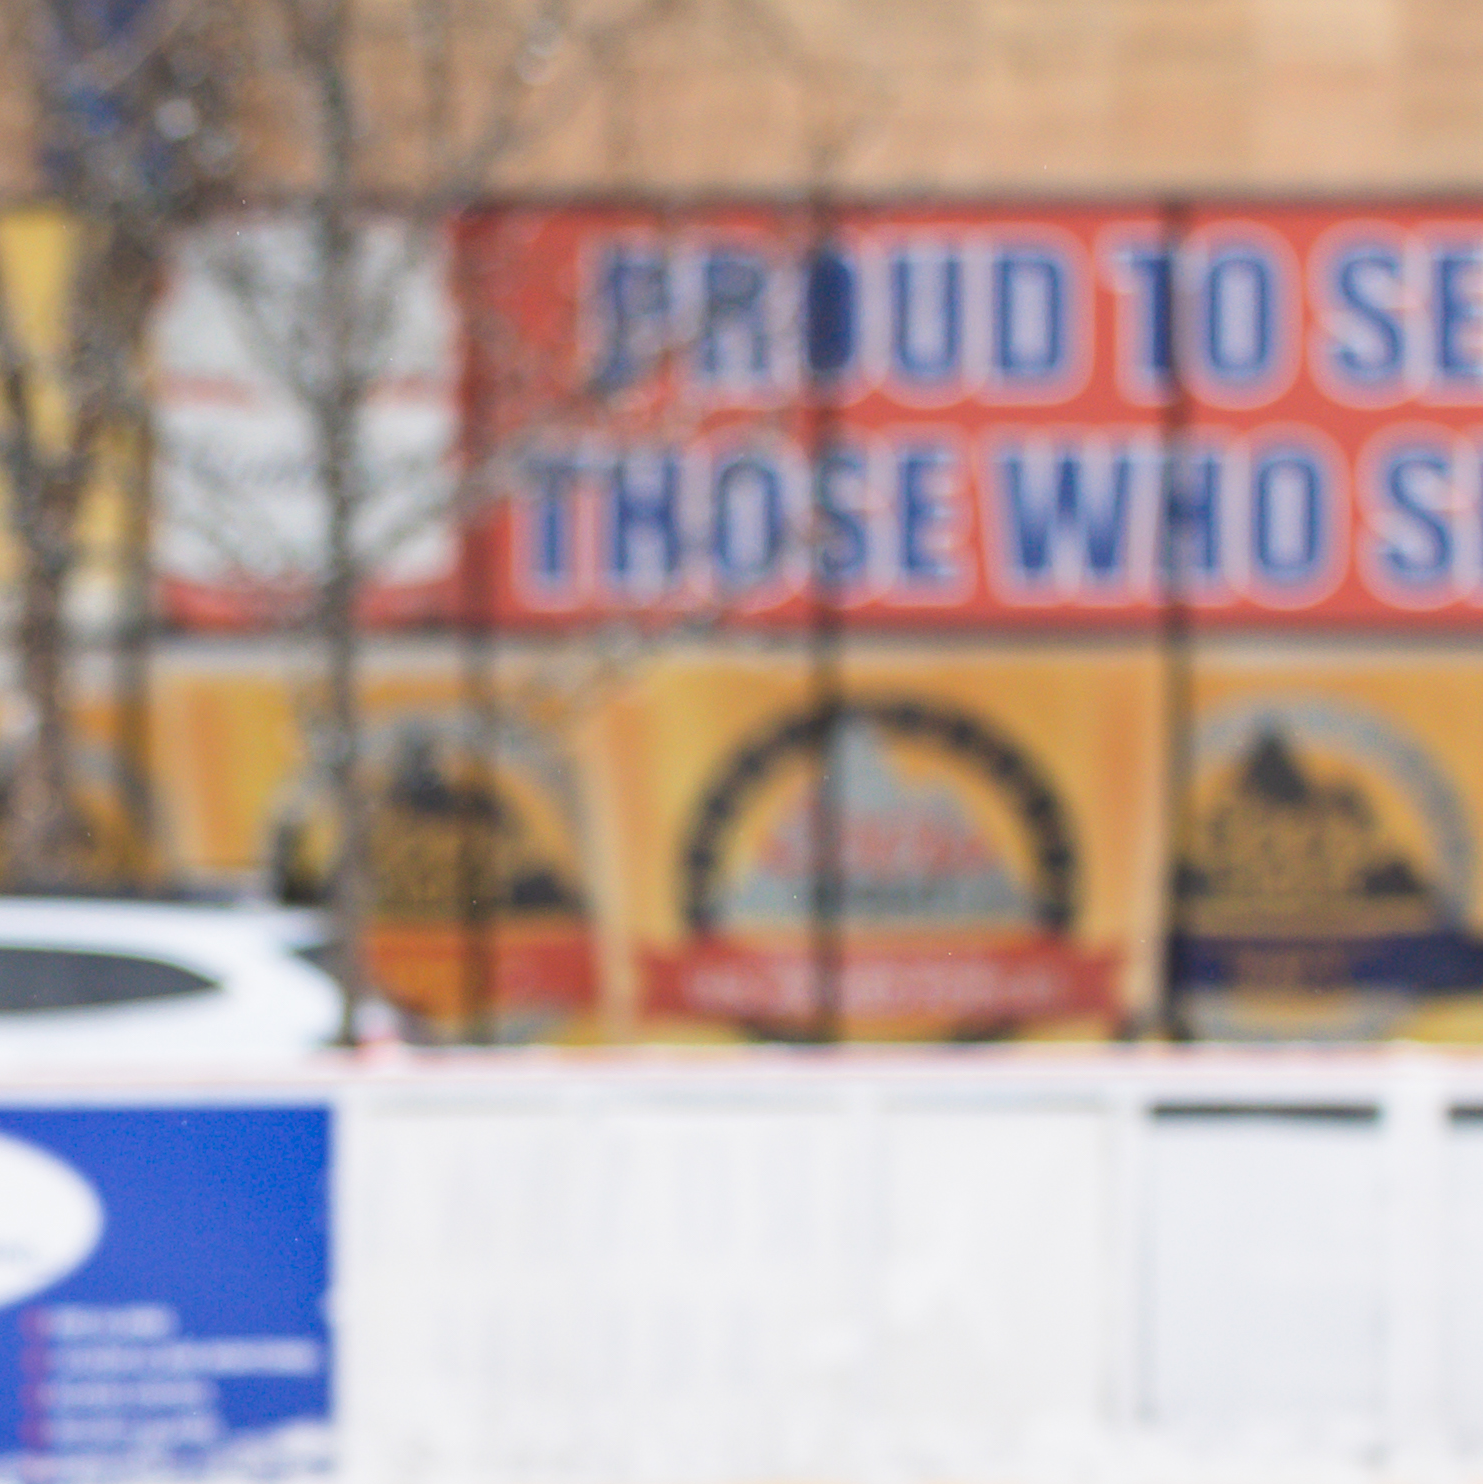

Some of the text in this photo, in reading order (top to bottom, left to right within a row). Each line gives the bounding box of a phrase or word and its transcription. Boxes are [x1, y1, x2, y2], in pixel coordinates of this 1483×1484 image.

[585, 236, 1075, 390] PROUD
[1107, 234, 1285, 390] TO
[519, 440, 961, 590] THOSE
[989, 438, 1337, 590] WHO
